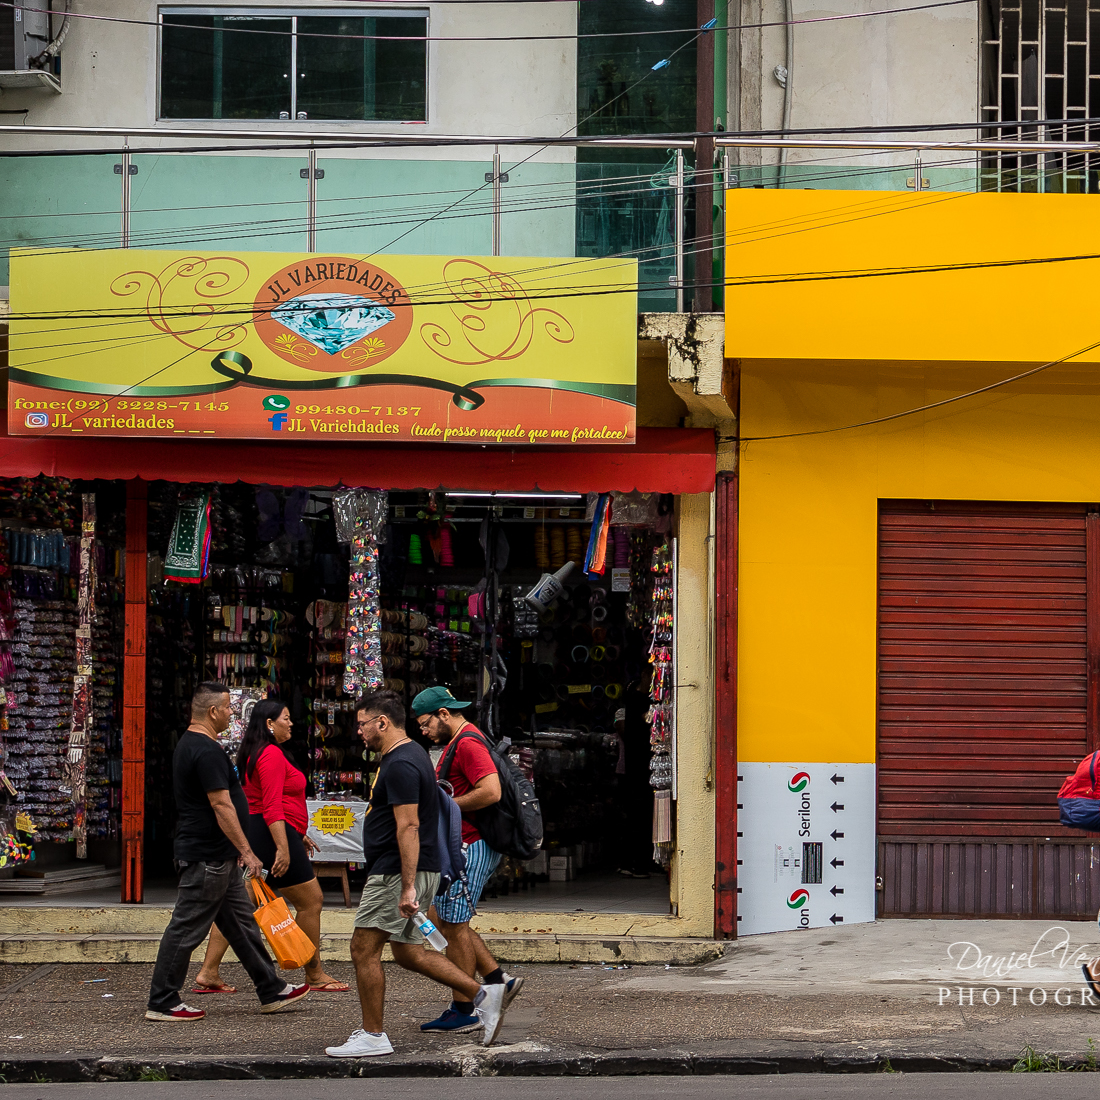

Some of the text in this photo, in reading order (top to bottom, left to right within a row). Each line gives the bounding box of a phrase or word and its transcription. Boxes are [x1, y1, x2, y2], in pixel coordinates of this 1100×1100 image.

[268, 263, 402, 305] JL VARIEDADES
[116, 400, 230, 411] 3228-7145
[295, 405, 422, 417] 99480-7137
[287, 418, 399, 434] JL Variehdades
[410, 422, 628, 443] (tudo posso naquele que me fortalece)
[798, 792, 811, 838] Serilon
